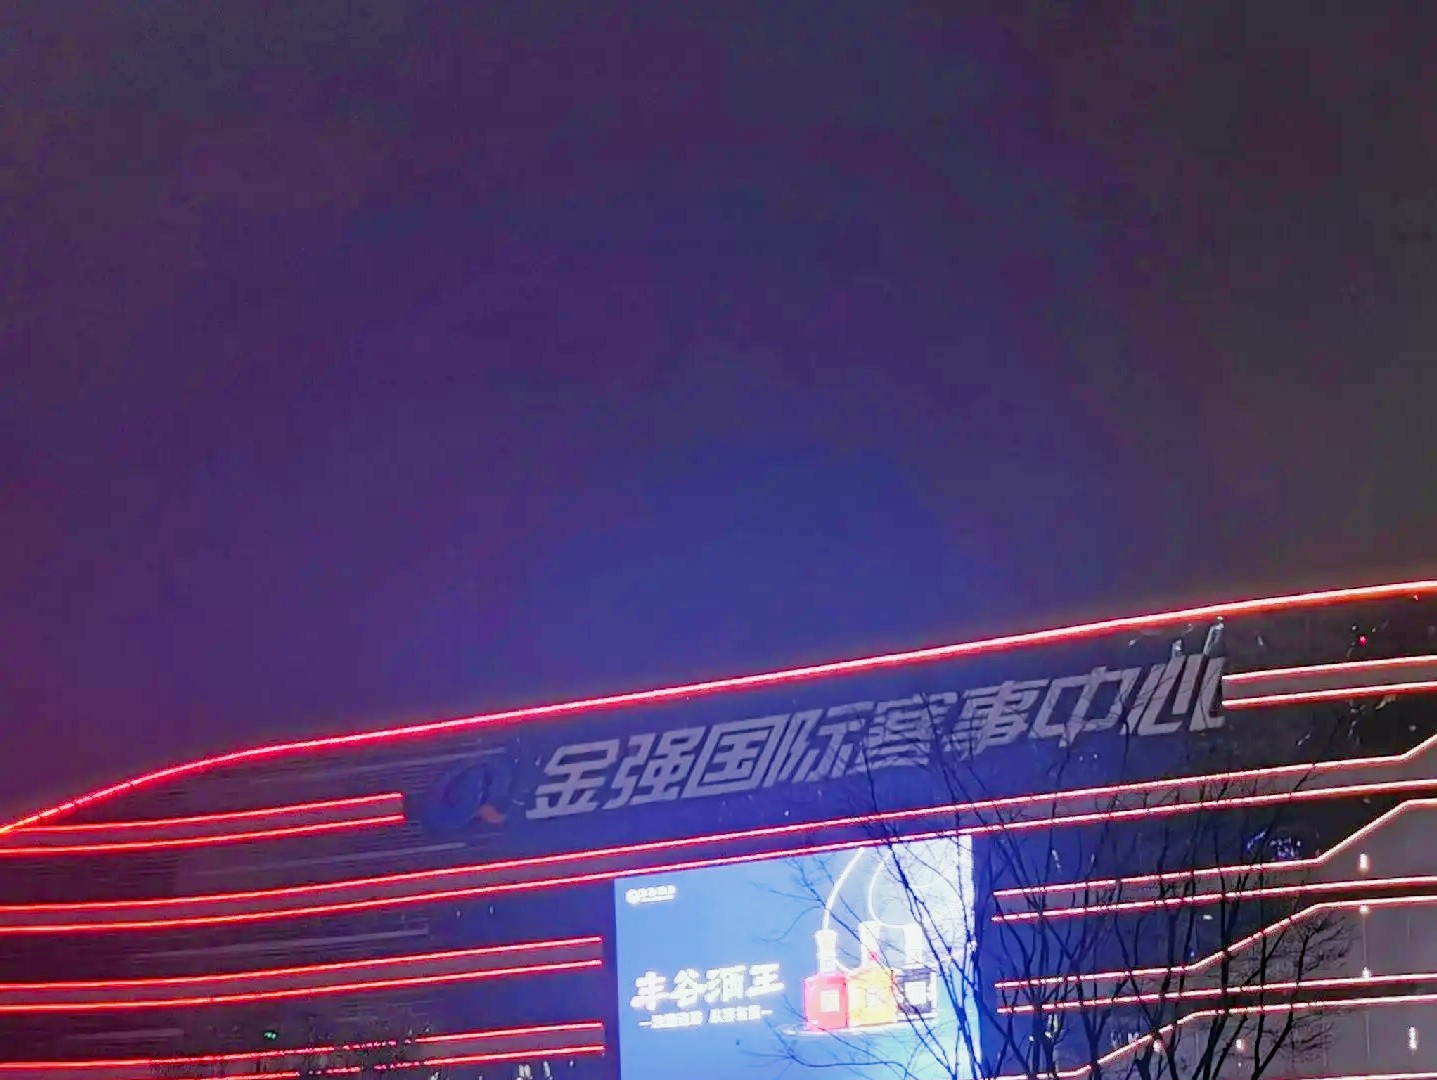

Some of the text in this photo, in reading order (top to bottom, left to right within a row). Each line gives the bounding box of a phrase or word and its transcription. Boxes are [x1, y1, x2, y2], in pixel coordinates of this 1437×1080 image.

[526, 654, 1226, 820] 金强国际赛事中心
[630, 963, 785, 1011] 丰谷酒王
